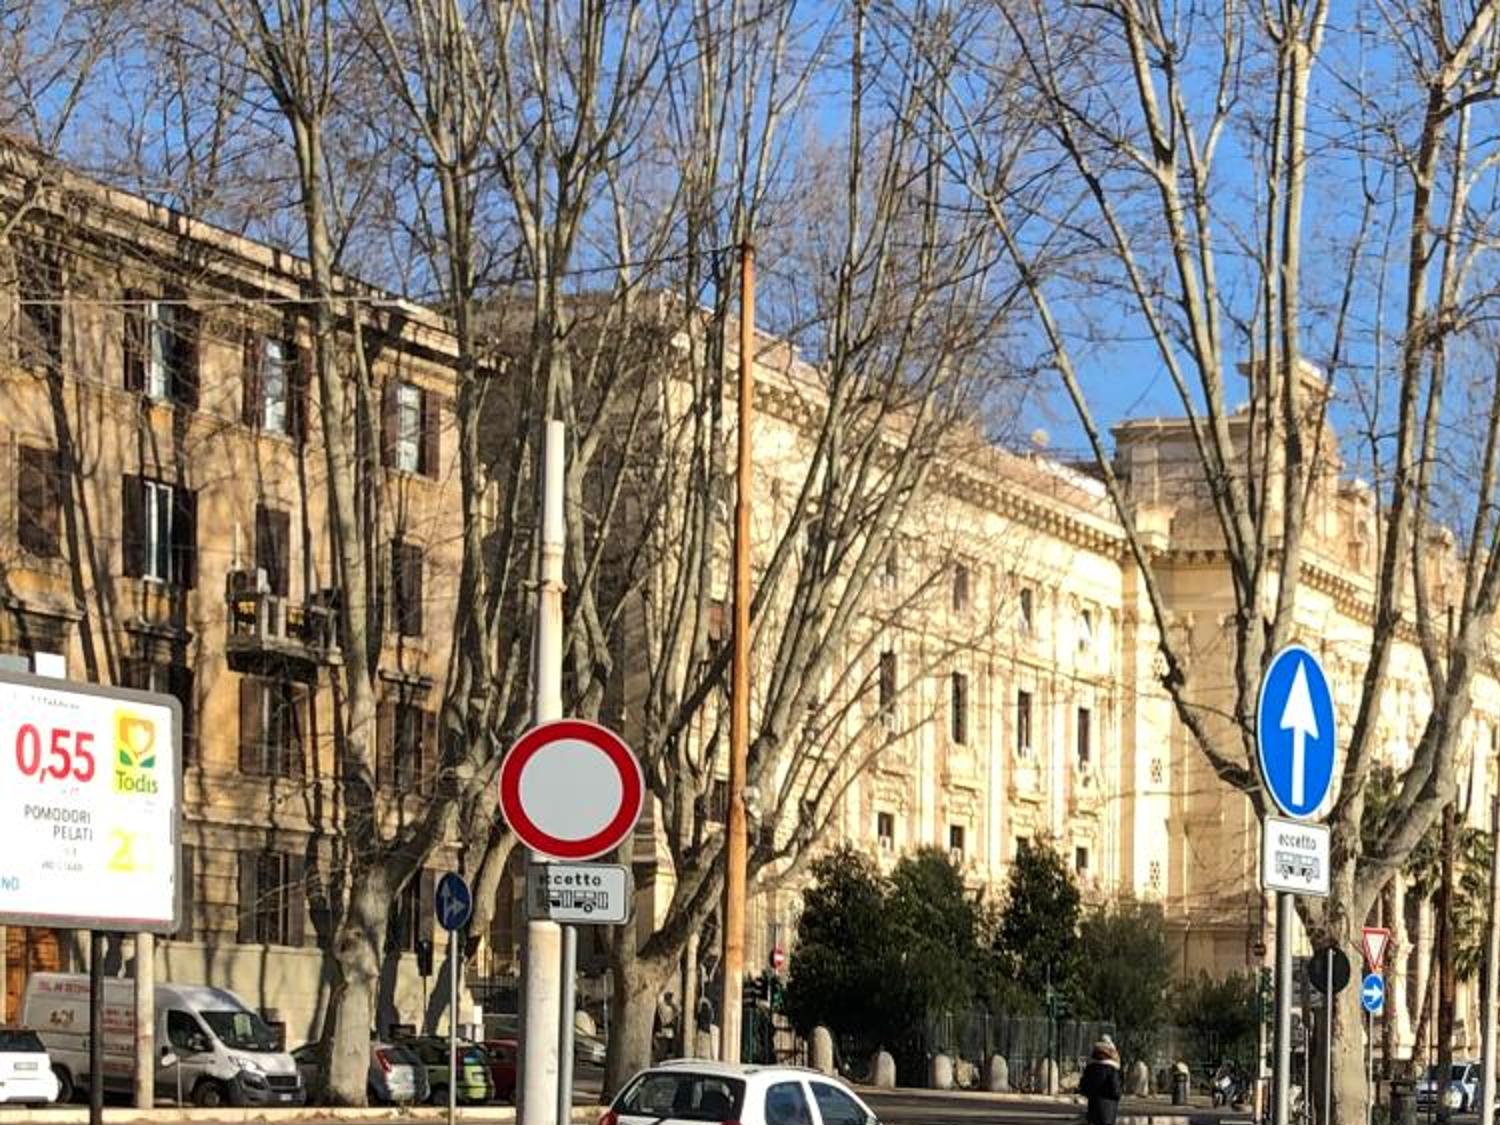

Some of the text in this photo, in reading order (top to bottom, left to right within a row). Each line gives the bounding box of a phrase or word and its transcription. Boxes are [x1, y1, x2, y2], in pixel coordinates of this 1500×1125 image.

[16, 724, 94, 783] 0,55
[115, 769, 158, 794] Todis
[24, 804, 91, 824] POMODORI
[53, 825, 93, 841] PELATI
[1279, 833, 1316, 850] eccetto
